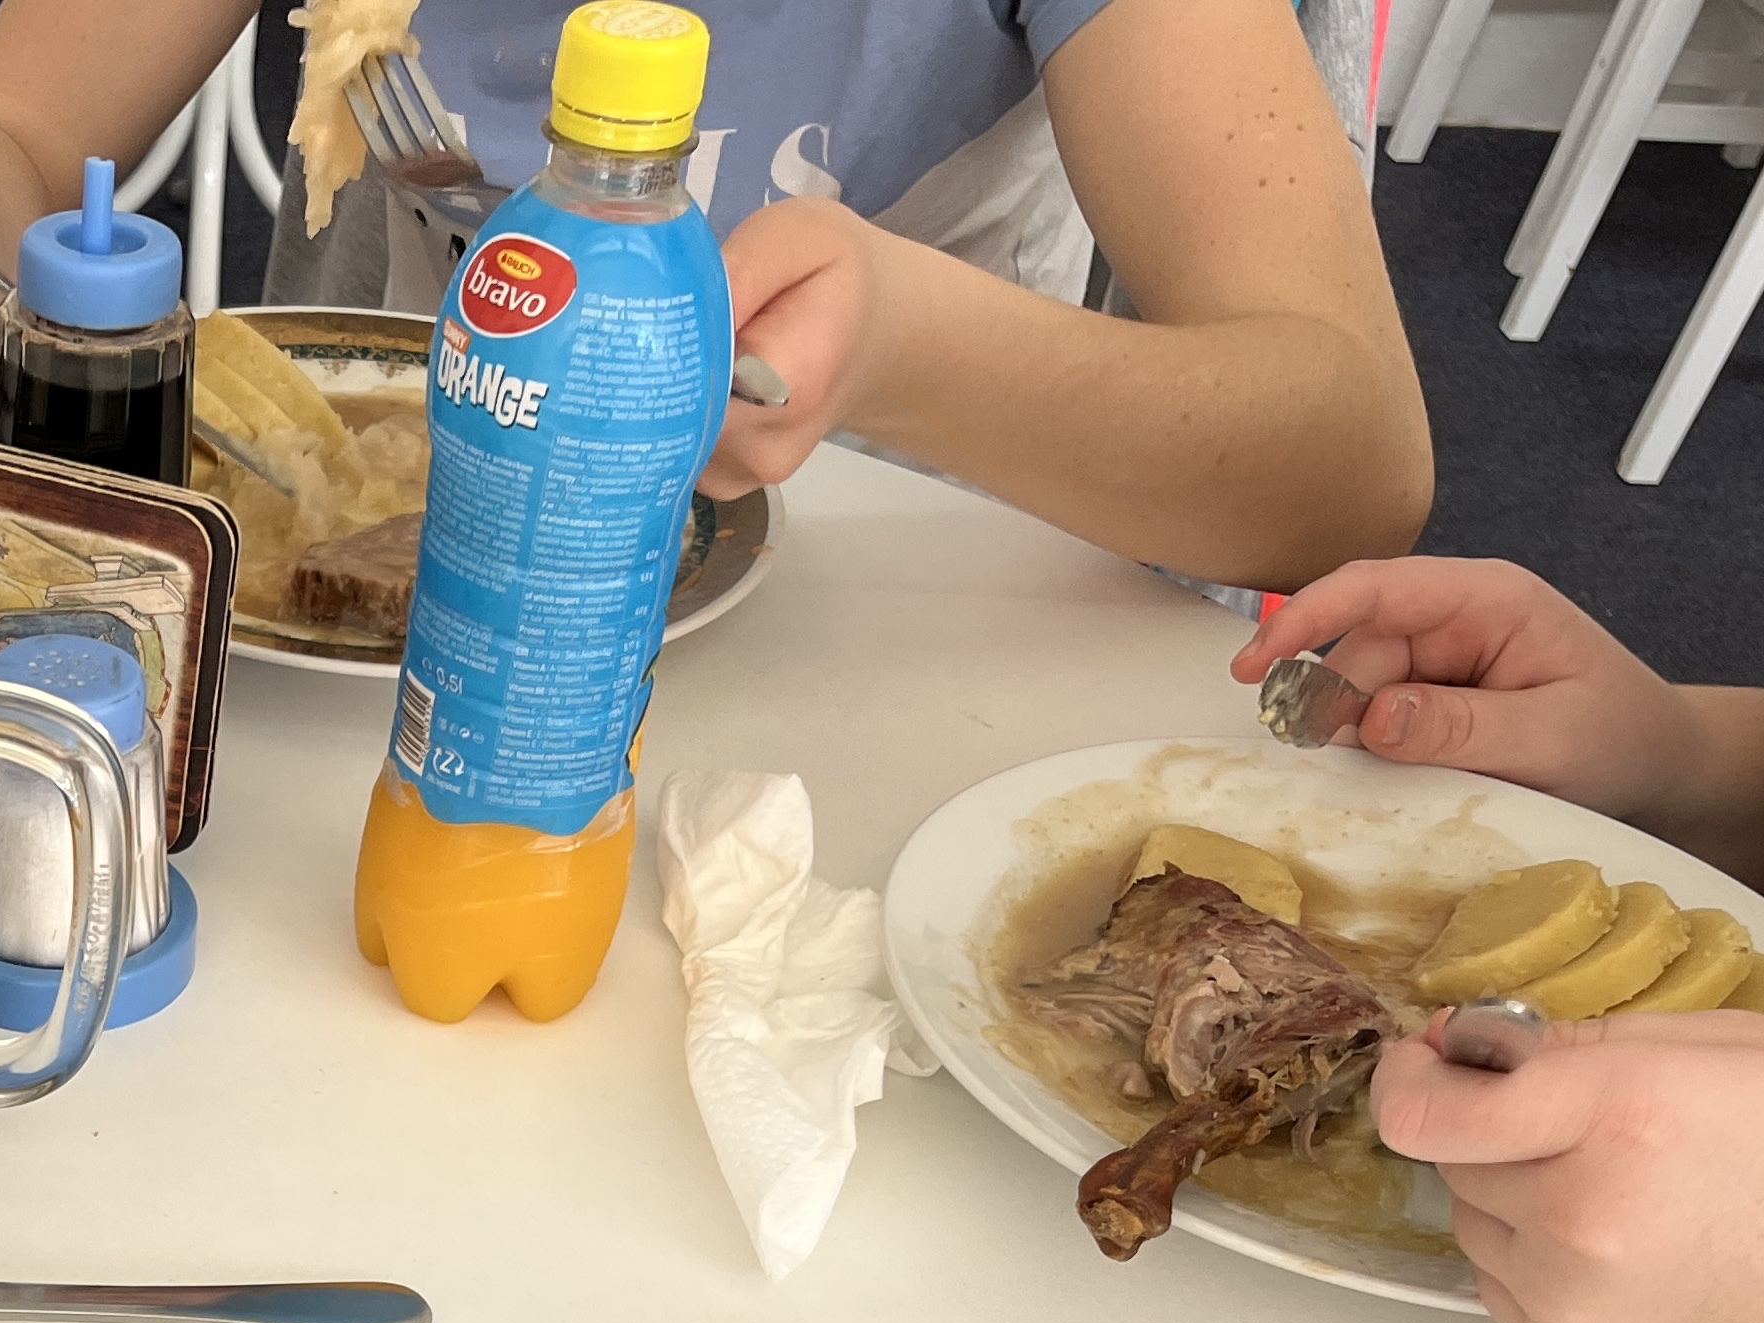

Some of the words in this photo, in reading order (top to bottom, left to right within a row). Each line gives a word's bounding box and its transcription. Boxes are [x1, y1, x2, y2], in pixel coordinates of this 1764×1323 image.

[467, 257, 547, 319] bravo
[506, 257, 536, 277] RAUCH
[437, 343, 549, 429] ORANGE
